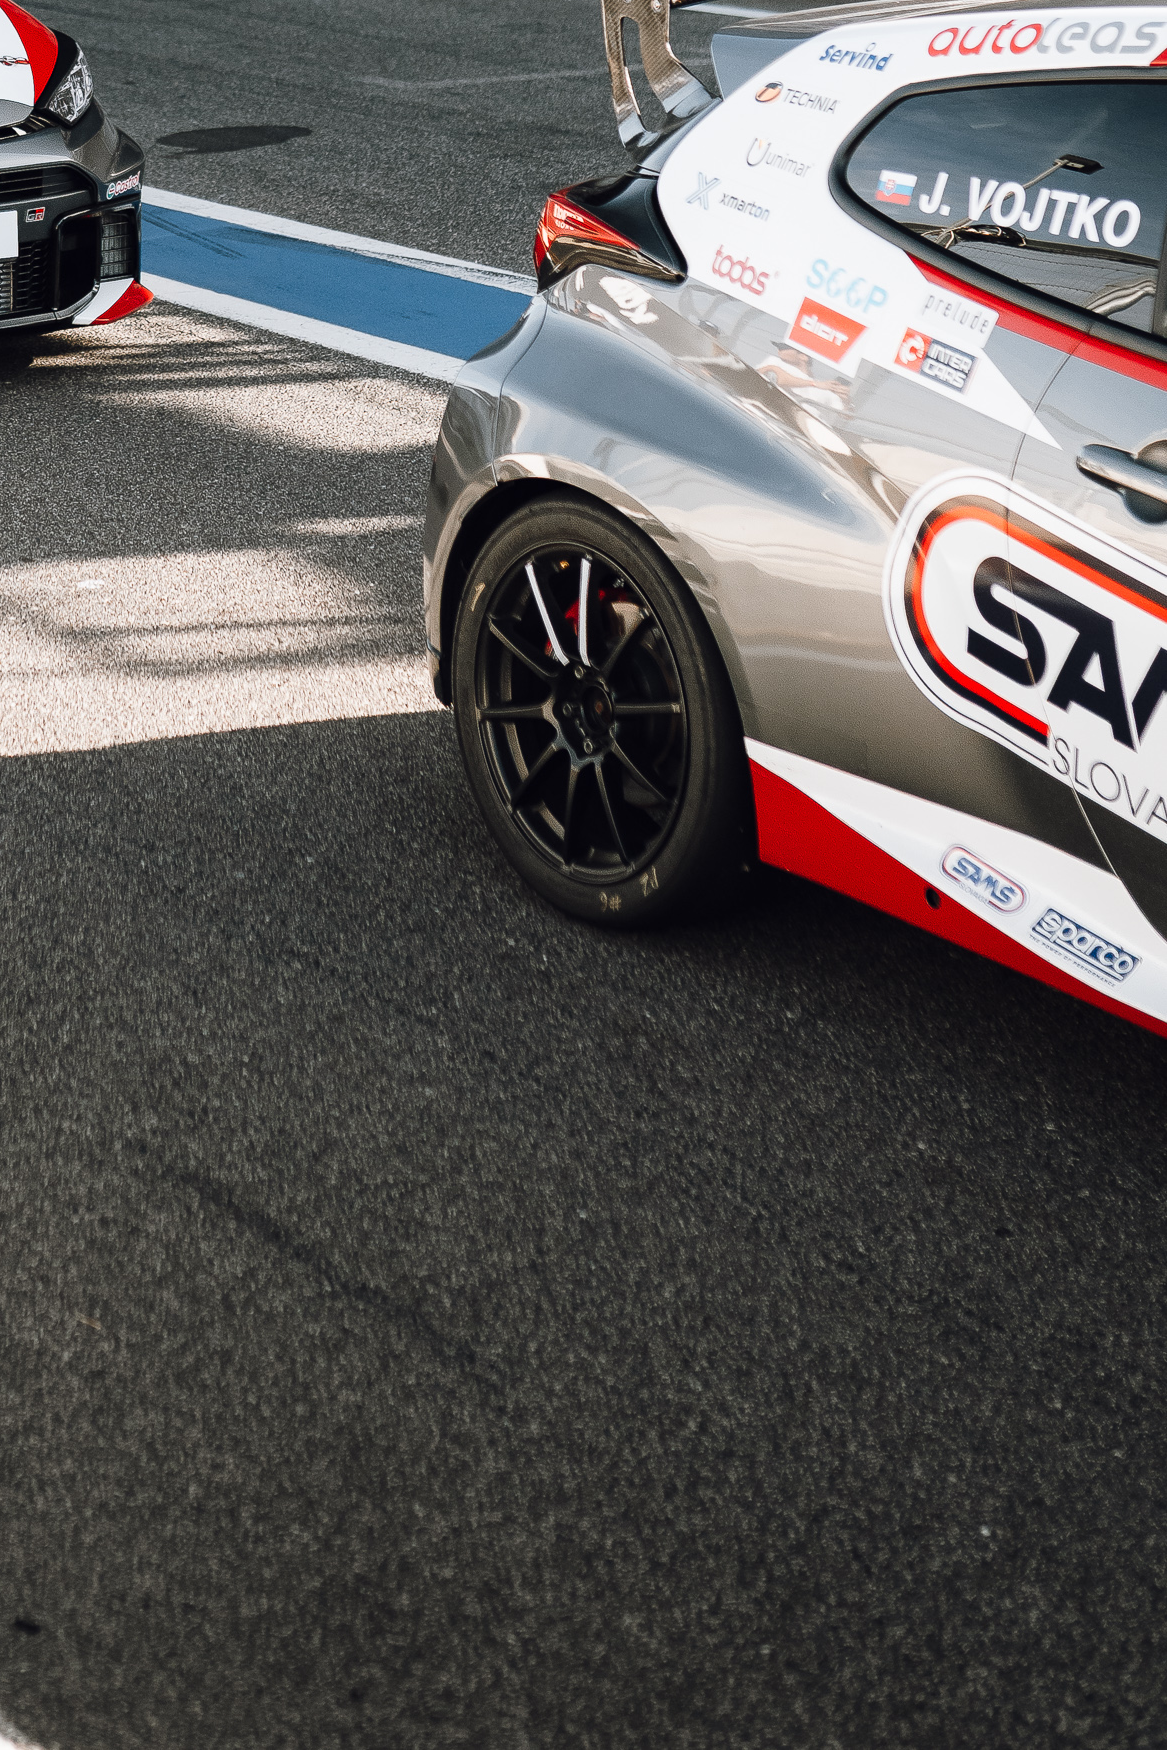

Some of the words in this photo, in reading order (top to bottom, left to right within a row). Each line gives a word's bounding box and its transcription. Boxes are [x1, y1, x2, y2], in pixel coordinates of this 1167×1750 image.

[928, 18, 1167, 58] autoleas
[785, 89, 838, 114] TECHNIA
[719, 192, 771, 222] xmarton
[918, 171, 951, 216] J.
[968, 176, 1141, 248] VOJTKO
[712, 245, 770, 296] todos
[921, 294, 989, 335] prelude
[921, 362, 965, 389] CARS
[929, 343, 973, 373] INTER
[952, 856, 1018, 906] SAMS
[1040, 912, 1135, 975] sparco
